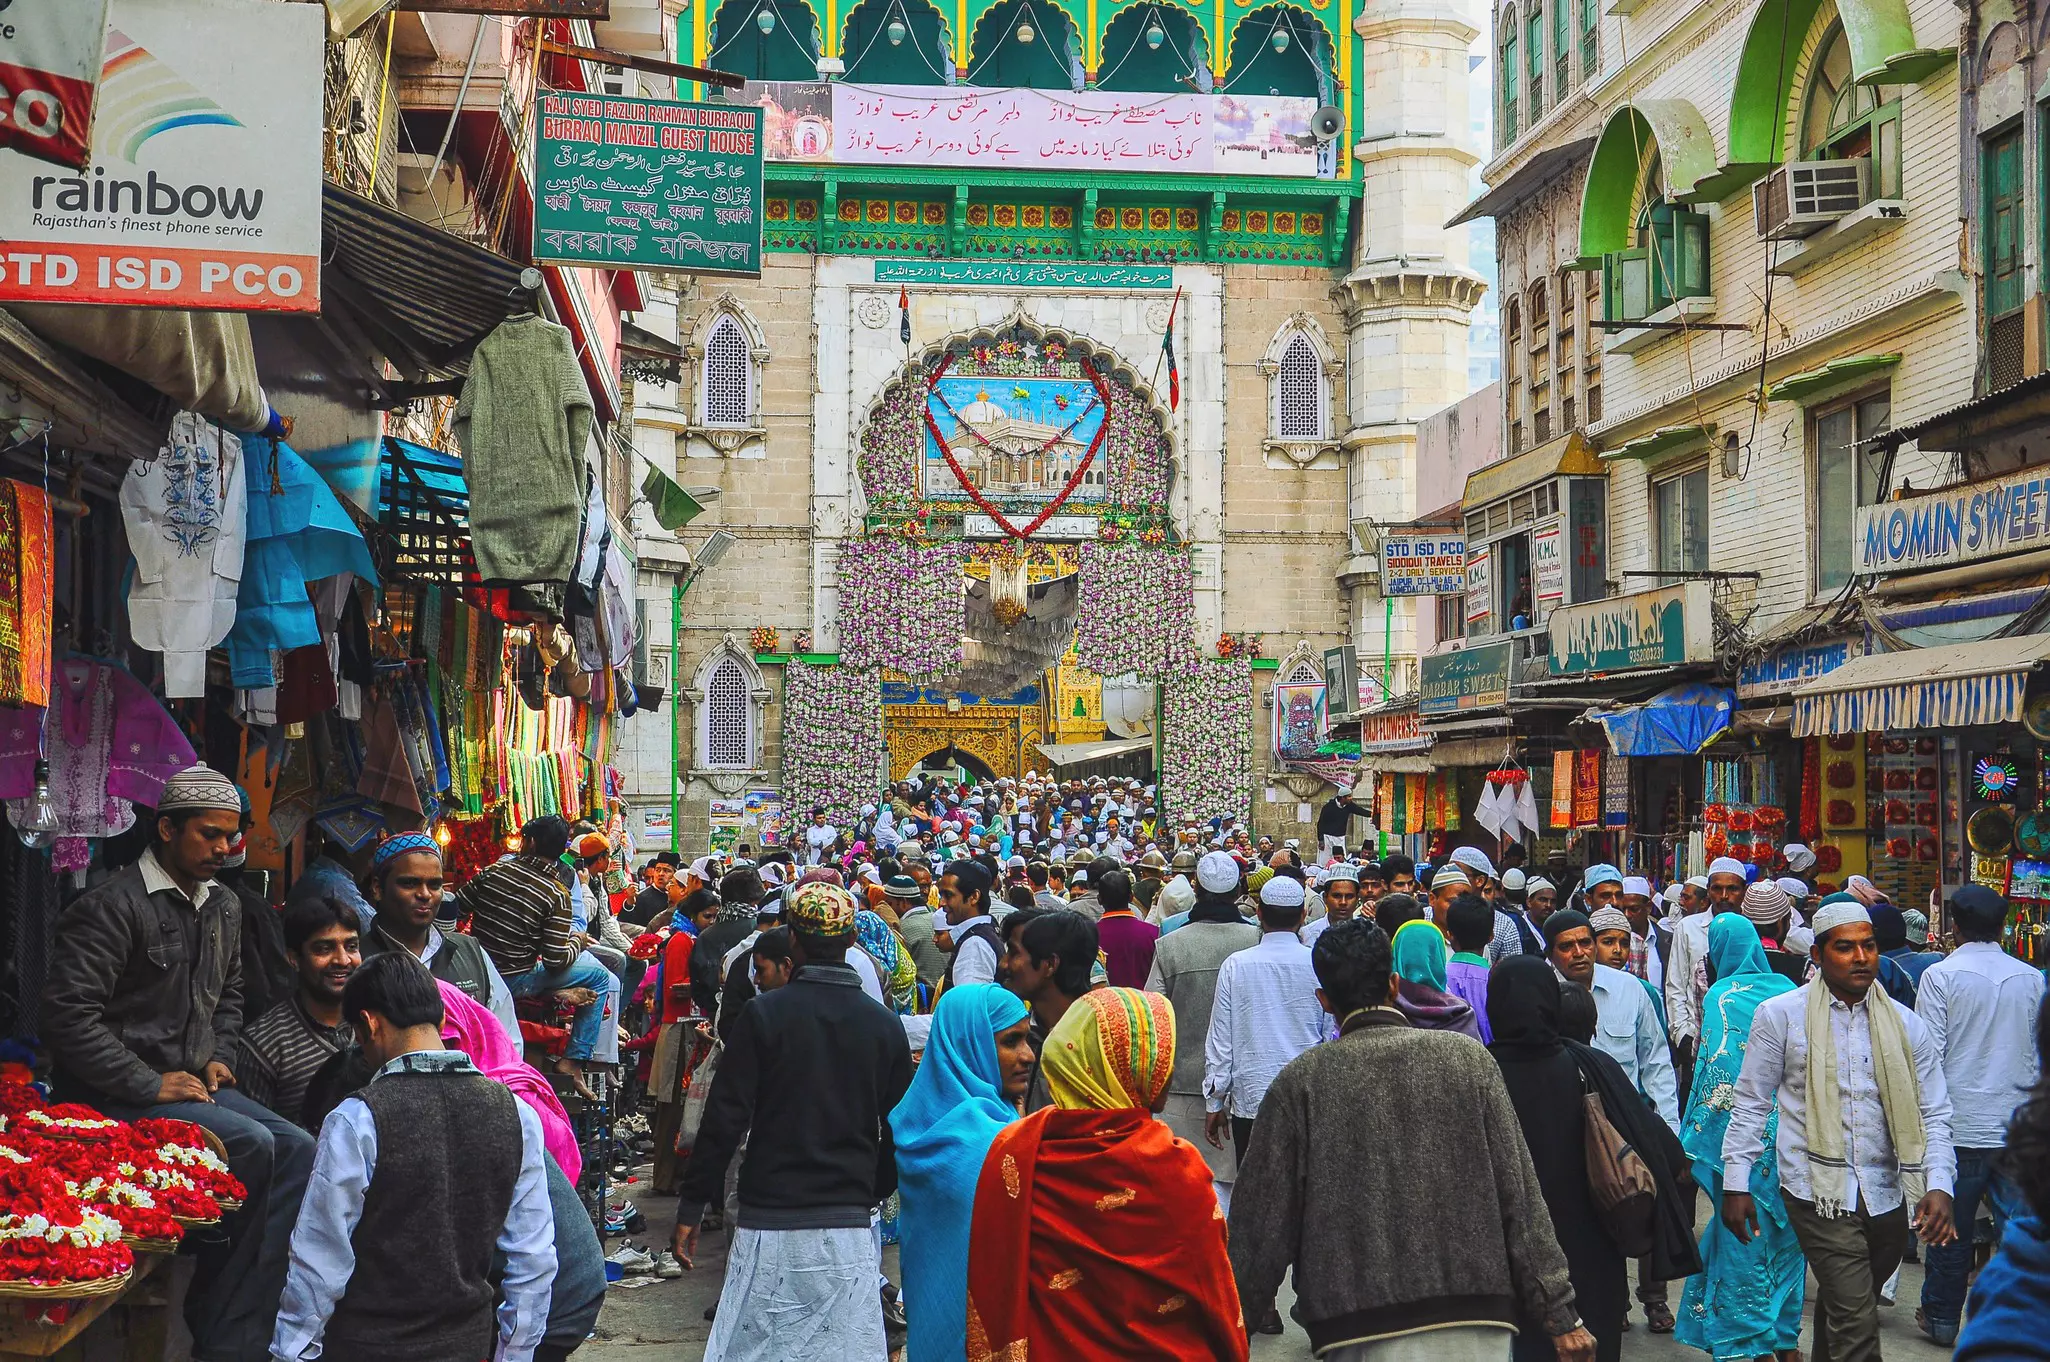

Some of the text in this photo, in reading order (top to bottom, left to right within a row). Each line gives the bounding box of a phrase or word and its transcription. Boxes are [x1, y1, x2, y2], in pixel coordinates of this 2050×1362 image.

[544, 97, 755, 131] HAJI SYED FAZLUR RAHMAN BURRAQUI
[544, 117, 754, 155] BURRAQ MANZIL GUEST HOUSE
[32, 166, 264, 221] rainbow
[32, 213, 263, 237] Rajasthan's finest phone service
[98, 256, 182, 291] ISD
[200, 261, 302, 298] PCO
[1864, 497, 1965, 568] MOMIN
[1386, 541, 1464, 557] STD ISD PCO
[1425, 555, 1462, 567] TRAVELS
[1388, 577, 1413, 586] JAIPUR
[1417, 576, 1439, 585] DLHI
[1406, 568, 1425, 576] DAILY
[1422, 671, 1507, 700] DARBAR SWEETS
